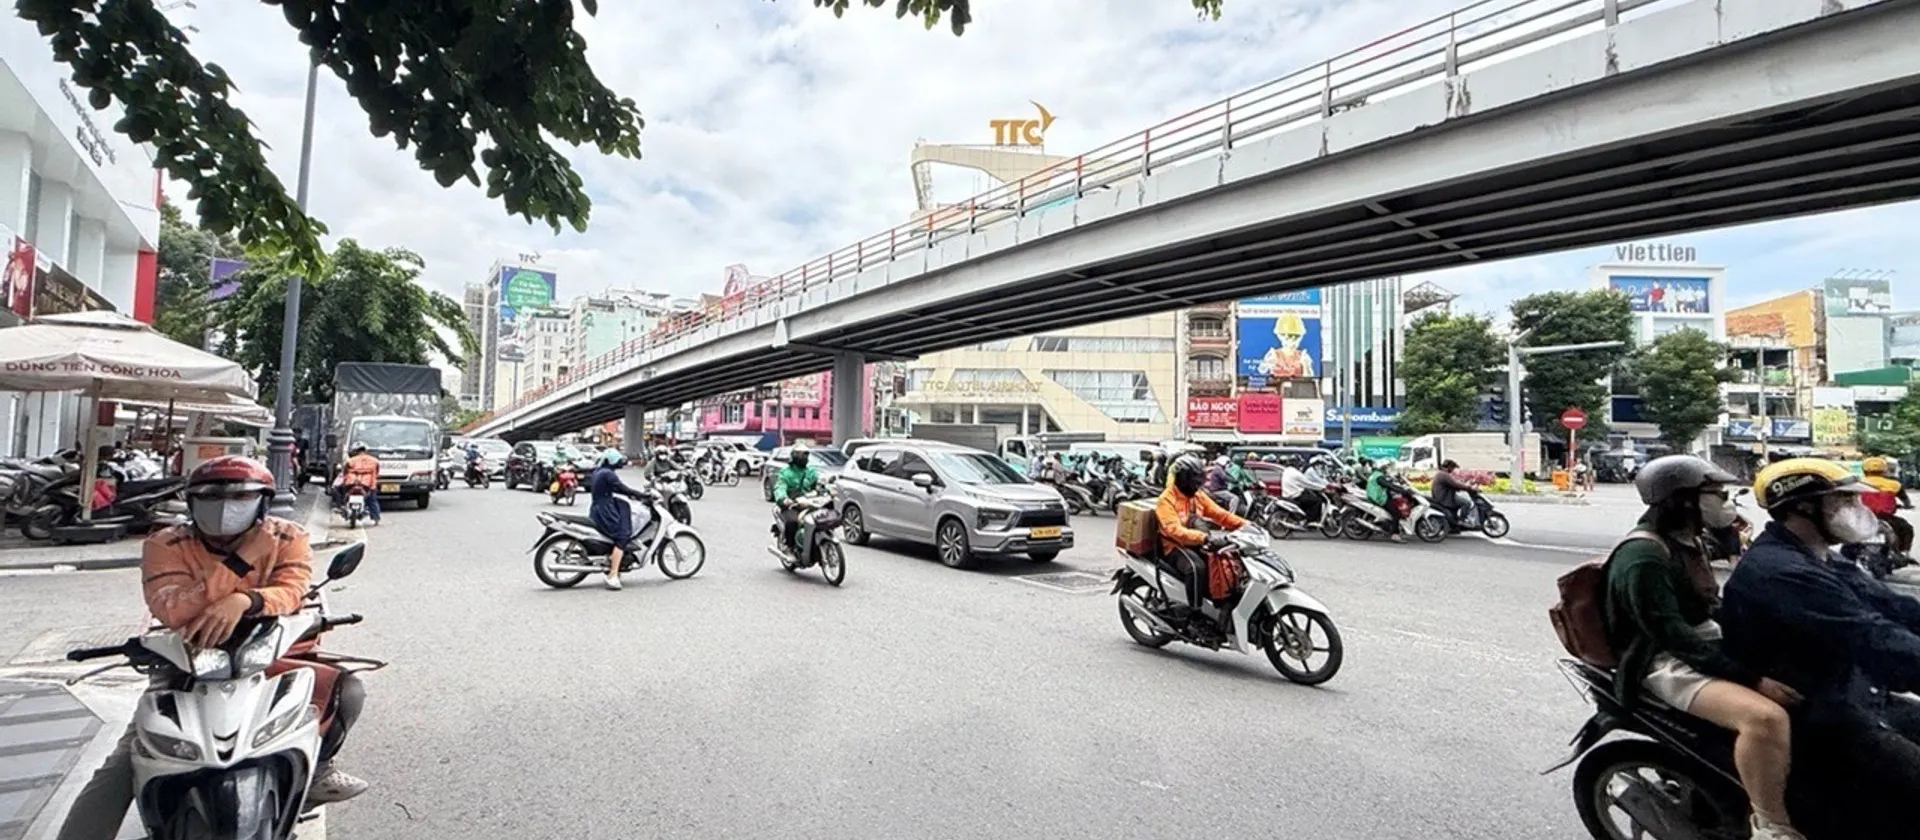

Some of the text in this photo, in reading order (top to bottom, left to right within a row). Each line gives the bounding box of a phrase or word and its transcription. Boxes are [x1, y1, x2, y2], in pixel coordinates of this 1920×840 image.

[990, 119, 1043, 146] TTC
[1616, 244, 1696, 262] viettien
[1326, 409, 1402, 422] Saombank
